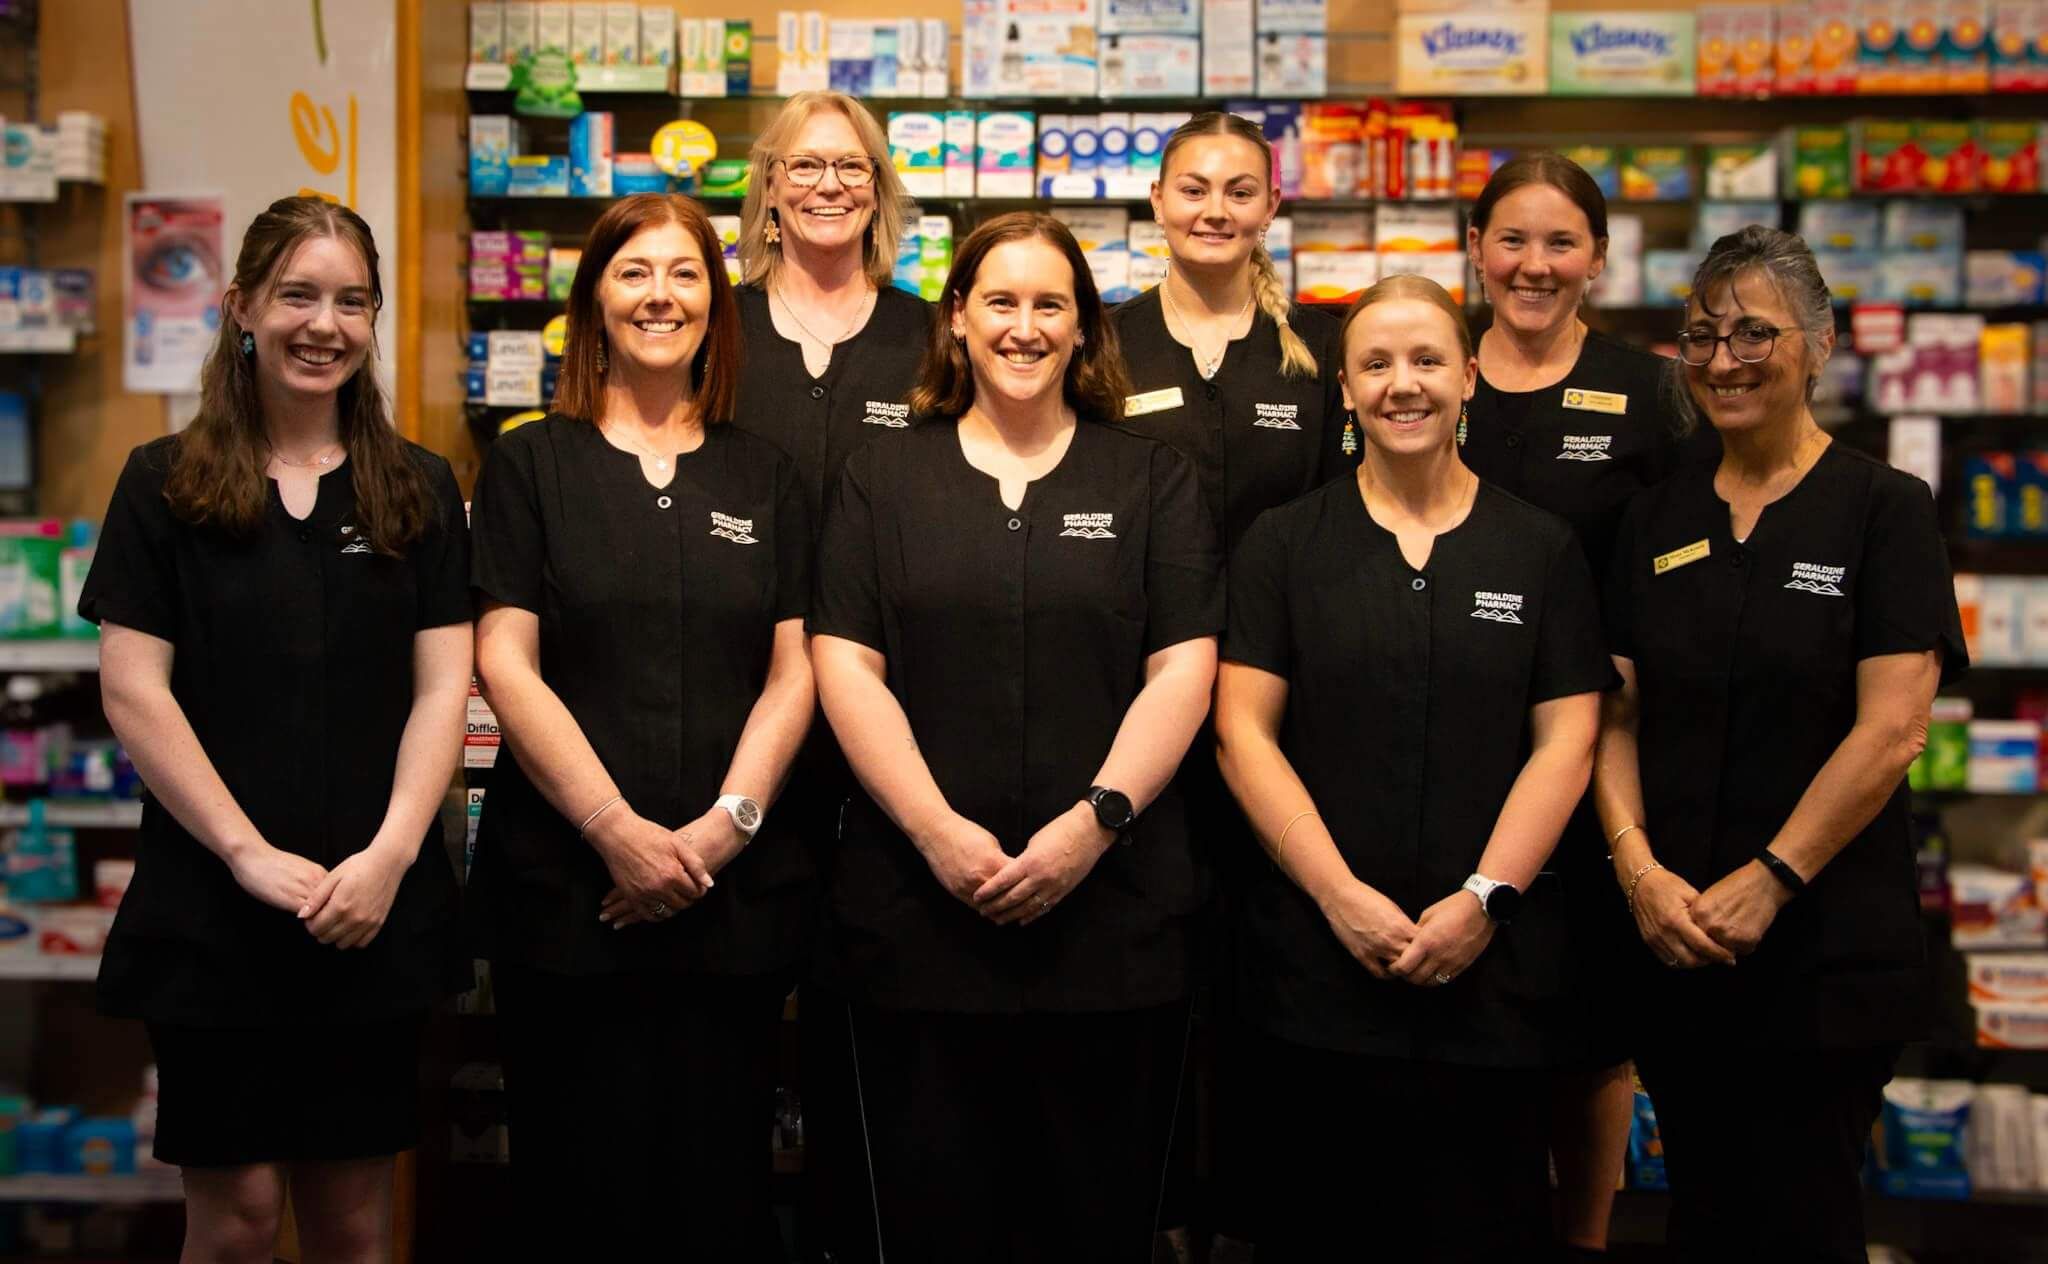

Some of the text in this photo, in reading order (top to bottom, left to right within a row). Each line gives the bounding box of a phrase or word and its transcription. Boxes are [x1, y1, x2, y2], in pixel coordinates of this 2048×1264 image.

[865, 401, 910, 411] GERALDINE
[1255, 403, 1298, 412] GERALDINE
[866, 408, 909, 418] PHARMACY
[1257, 410, 1297, 419] PHARMACY
[1563, 435, 1612, 443] GERALDINE
[711, 511, 753, 527] GERALDINE
[1063, 513, 1113, 521] GERALDINE
[712, 518, 752, 534] PHARMACY
[1064, 520, 1112, 528] PHARMACY
[1793, 562, 1846, 575] GERALDINE
[1792, 570, 1843, 583] PHARMACY
[1475, 592, 1523, 603] GERALDINE
[1475, 600, 1522, 611] PHARMACY
